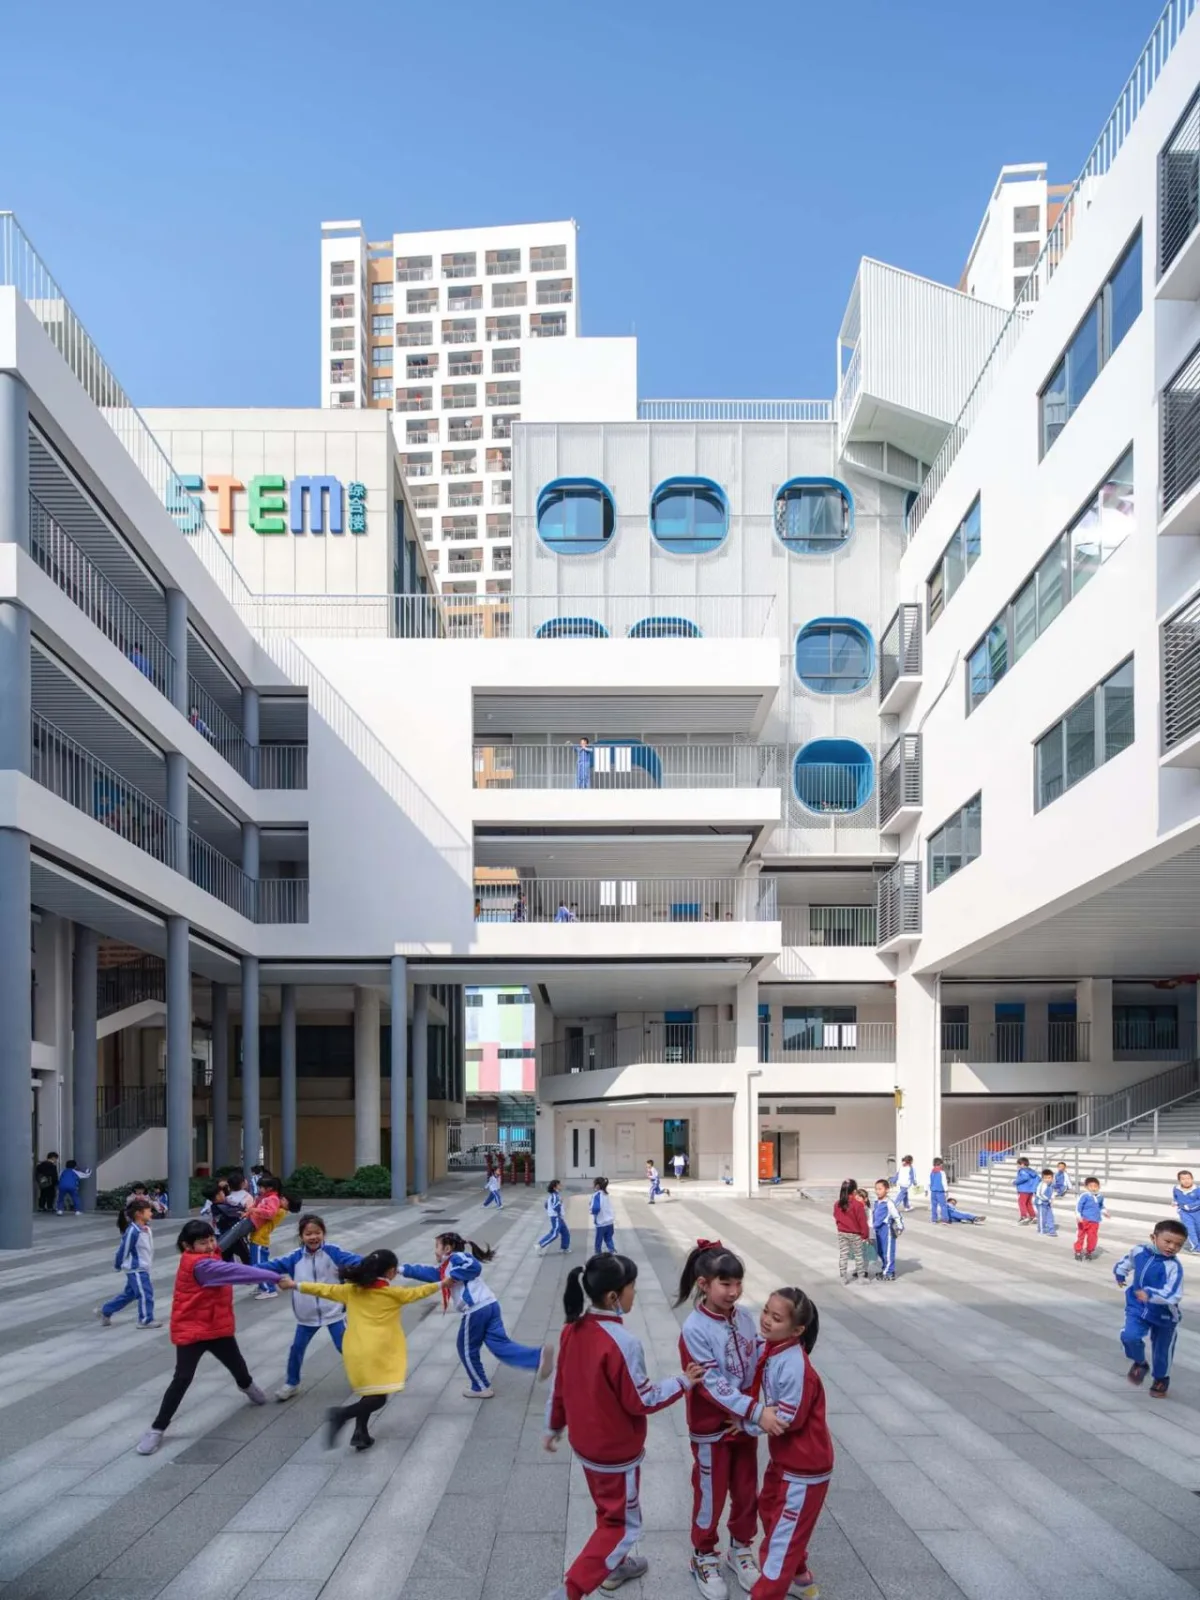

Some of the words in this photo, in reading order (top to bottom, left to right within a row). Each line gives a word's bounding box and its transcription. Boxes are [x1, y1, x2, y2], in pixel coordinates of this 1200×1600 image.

[166, 474, 343, 534] STEM
[348, 481, 366, 533] 综合楼
